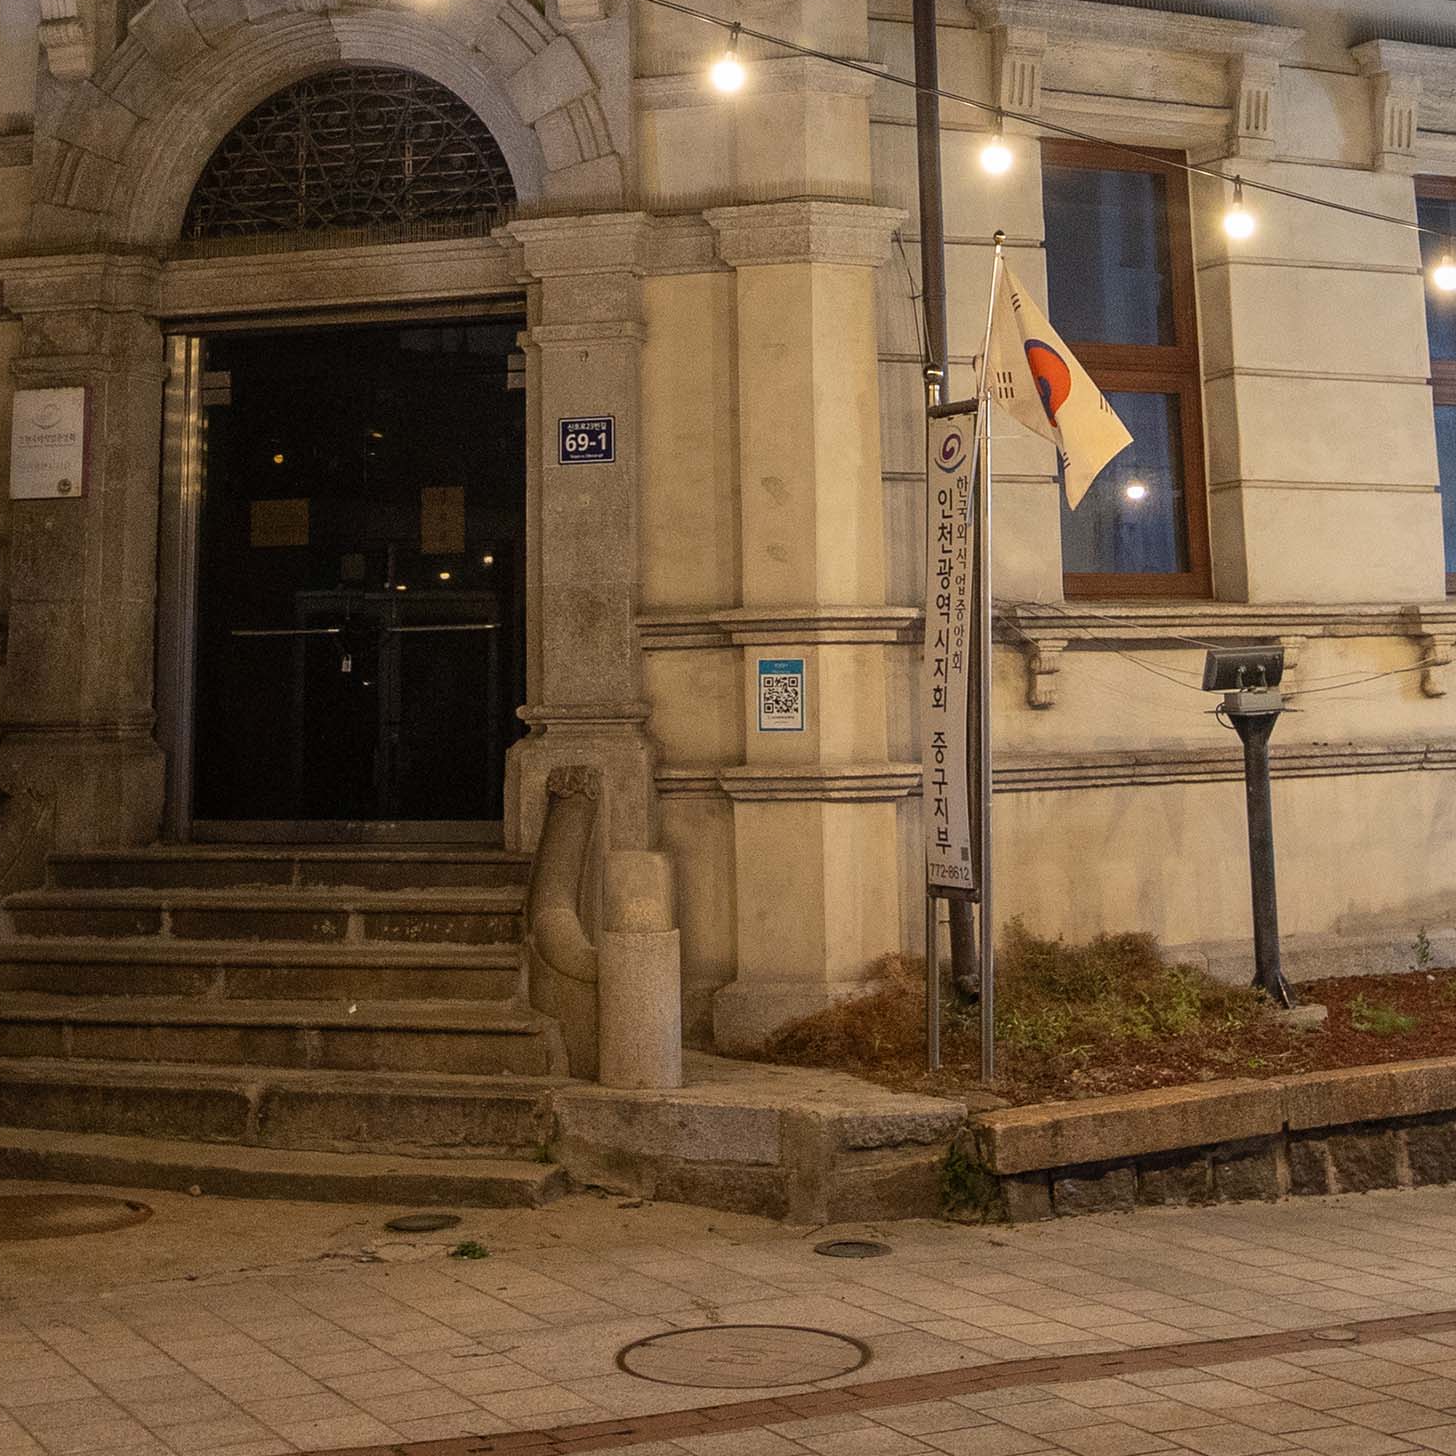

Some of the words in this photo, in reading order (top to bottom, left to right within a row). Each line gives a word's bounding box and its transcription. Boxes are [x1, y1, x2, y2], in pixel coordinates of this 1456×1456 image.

[565, 432, 607, 452] 69-1
[931, 487, 954, 713] 인천광역시지회
[951, 474, 969, 675] 한국외식업중앙회
[931, 731, 952, 856] 중구지부
[929, 862, 970, 881] 772-8612
